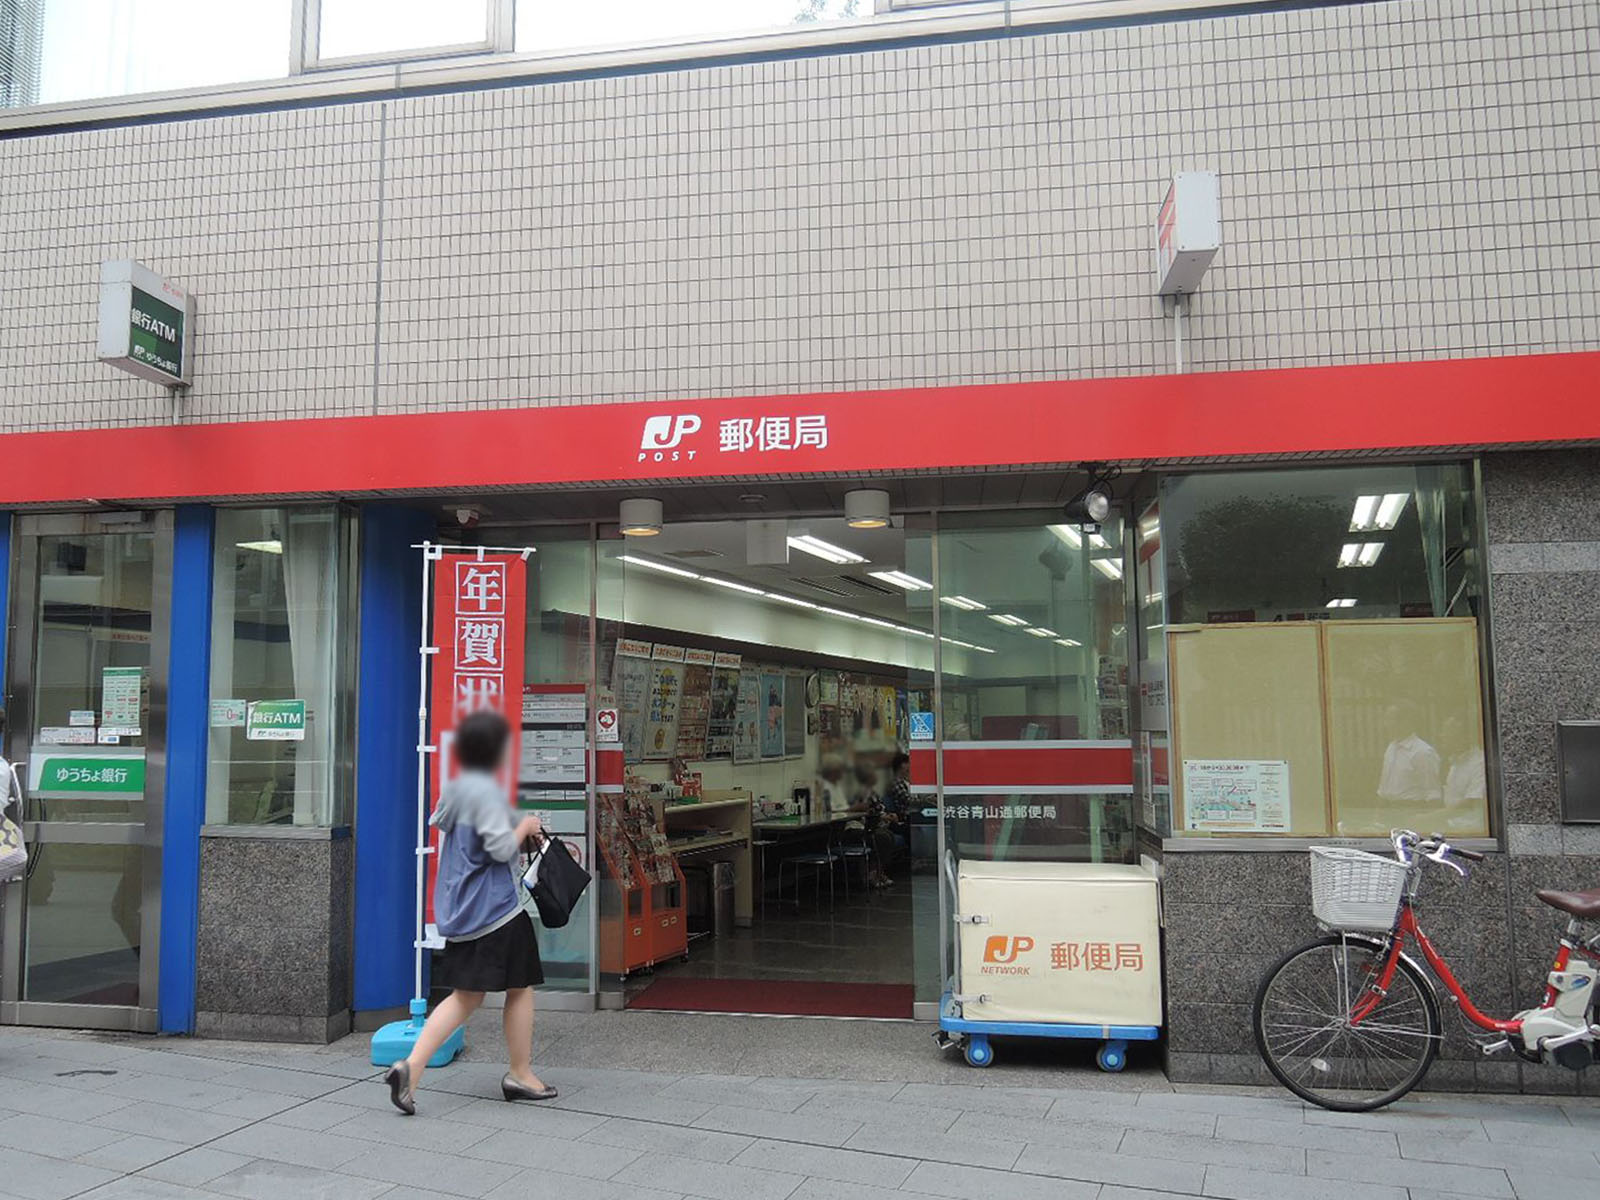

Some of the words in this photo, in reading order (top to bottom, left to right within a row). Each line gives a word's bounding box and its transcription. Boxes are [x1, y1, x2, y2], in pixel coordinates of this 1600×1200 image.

[131, 307, 176, 342] 銀行ATM
[640, 414, 702, 450] JP
[719, 415, 829, 453] 郵便局
[638, 451, 696, 463] POST
[252, 712, 301, 724] 銀行ATM
[56, 767, 128, 783] ゆうちょ銀行
[944, 805, 1057, 819] 渋谷青山通郵便局
[983, 936, 1034, 964] JP
[1050, 942, 1144, 972] 郵便局
[981, 966, 1030, 975] NETWORK
